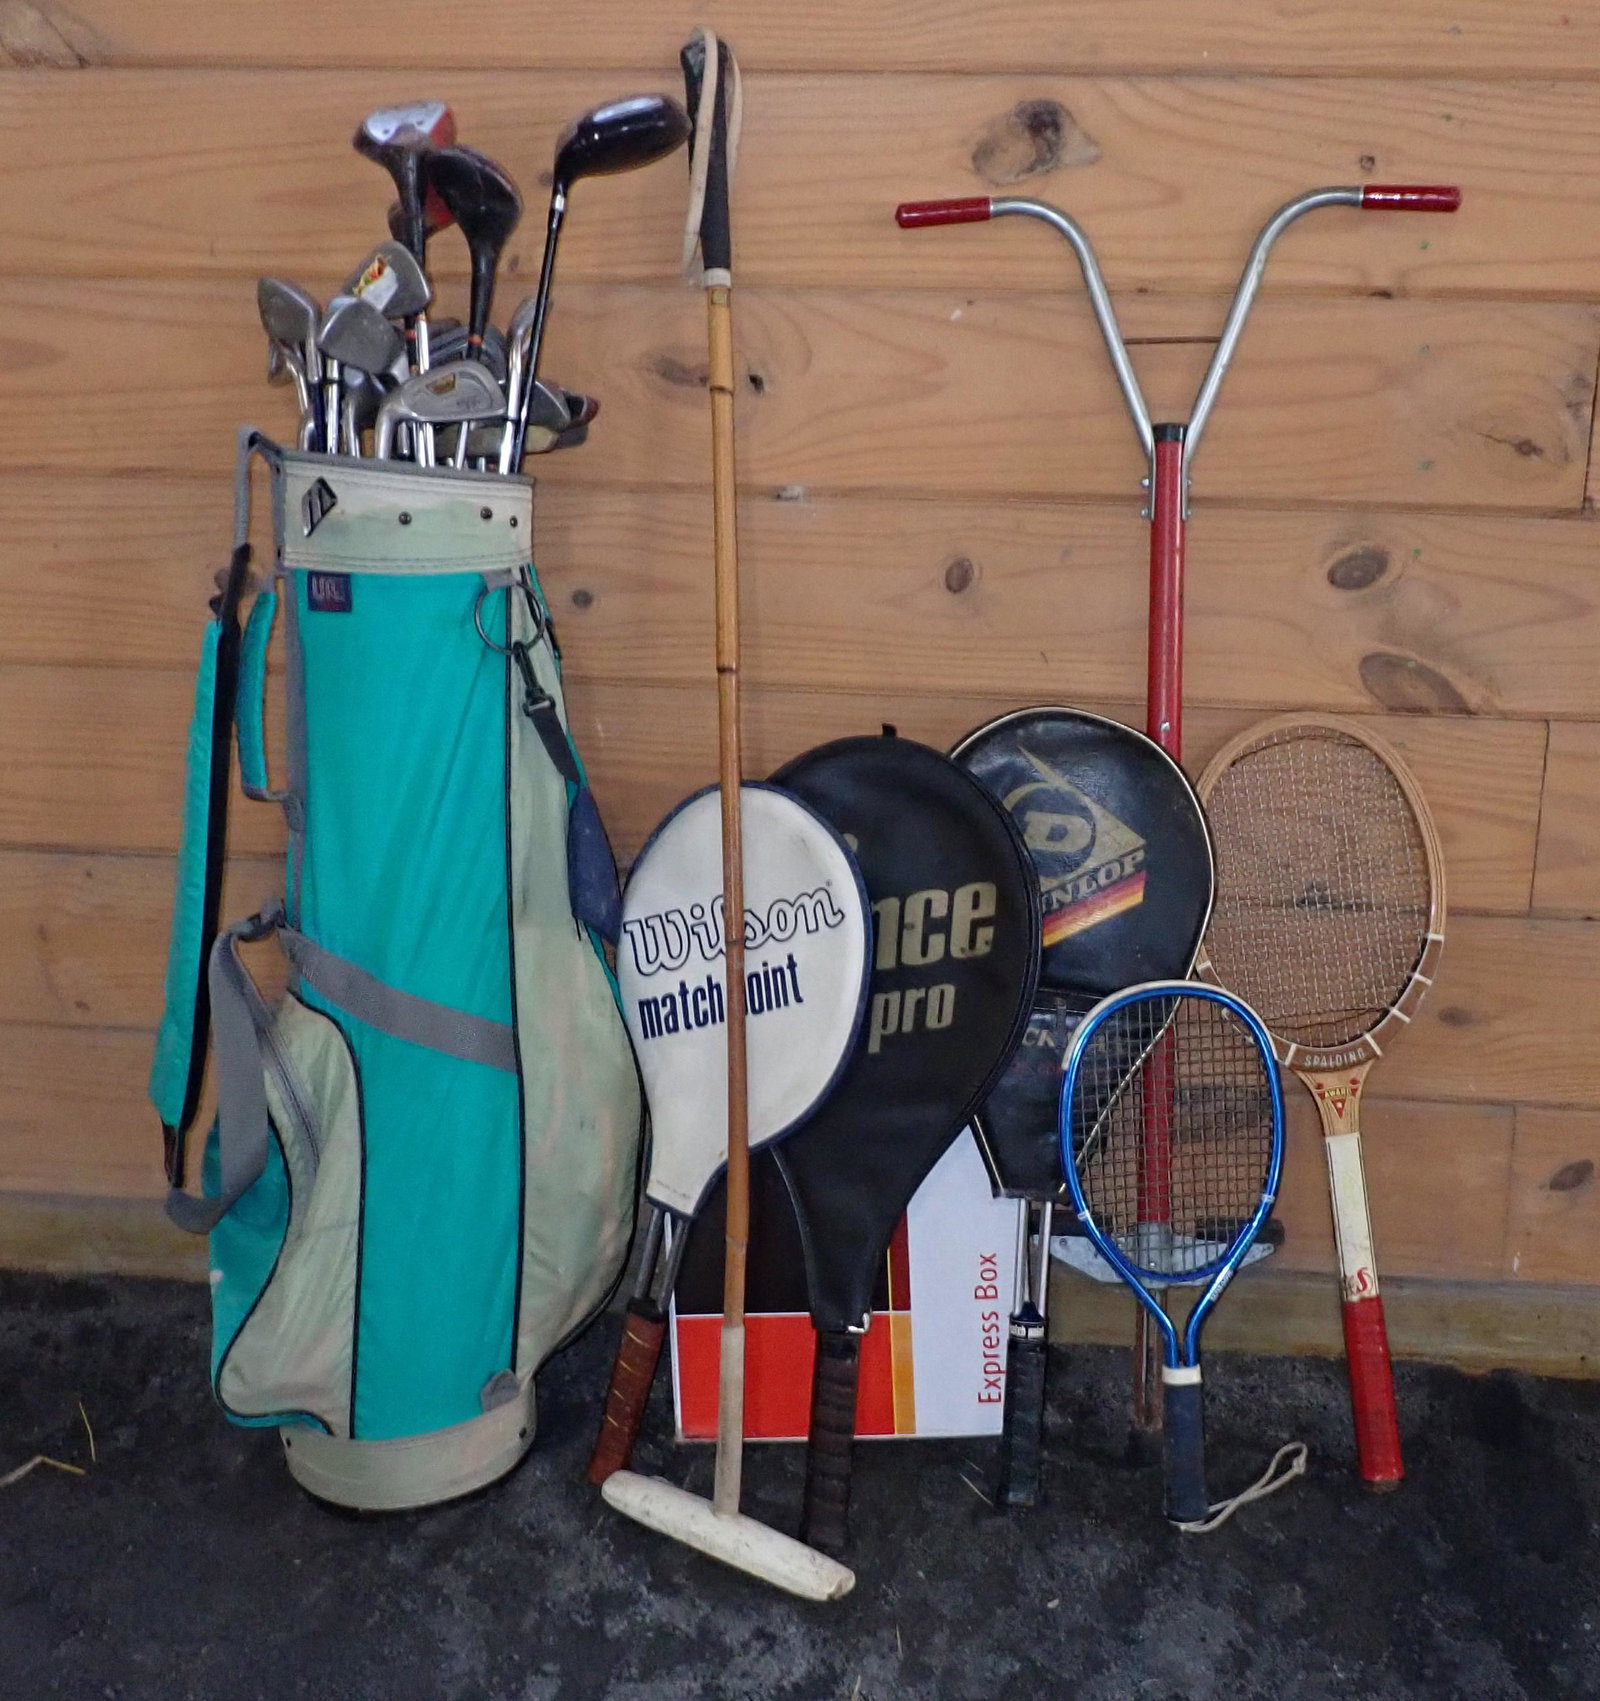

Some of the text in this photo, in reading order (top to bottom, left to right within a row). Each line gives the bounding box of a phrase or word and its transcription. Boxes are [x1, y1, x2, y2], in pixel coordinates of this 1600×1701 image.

[1041, 849, 1146, 914] NLOP
[638, 953, 804, 1040] match oint
[868, 983, 956, 1054] pro
[974, 1253, 1007, 1403] Express Box
